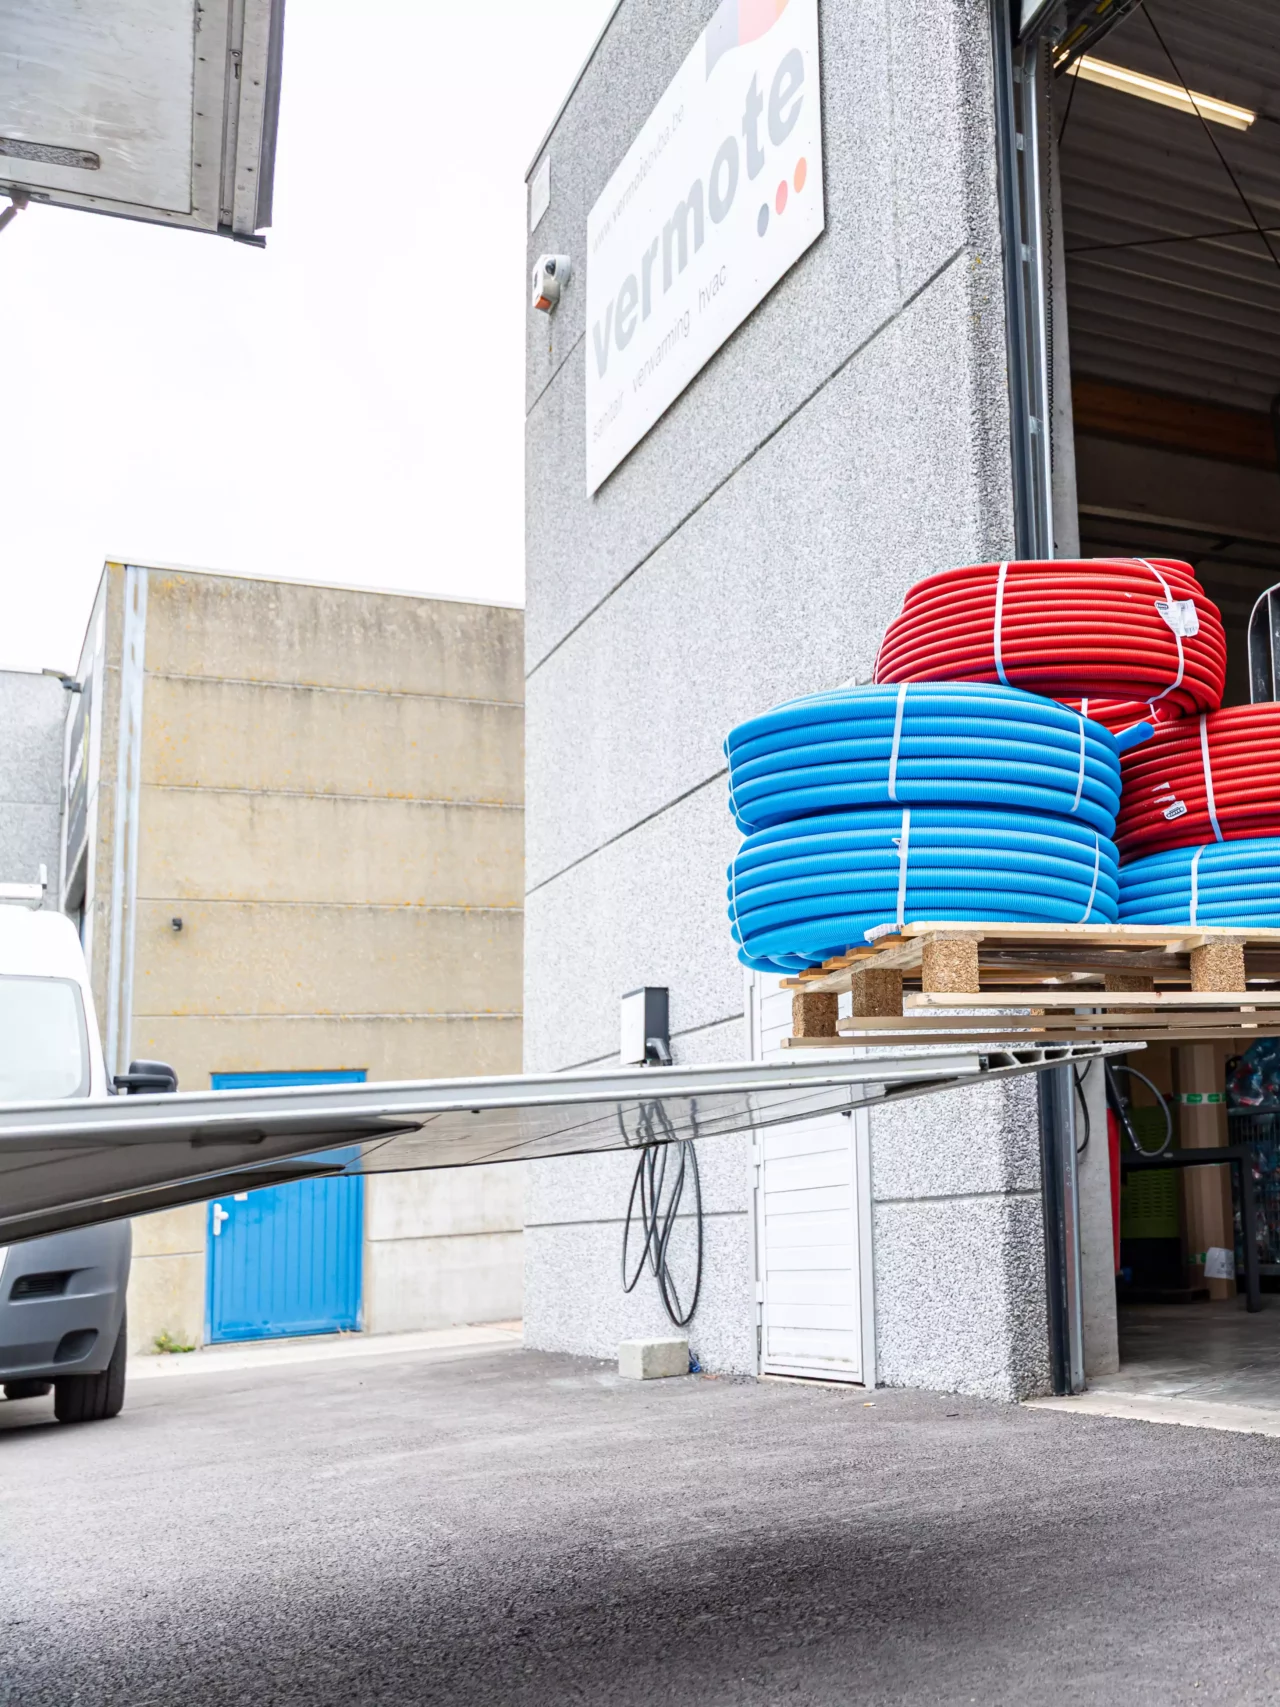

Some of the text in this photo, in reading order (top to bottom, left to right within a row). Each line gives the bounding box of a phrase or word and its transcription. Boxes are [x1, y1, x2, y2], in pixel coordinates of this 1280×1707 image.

[592, 47, 805, 379] vermote
[632, 309, 690, 393] verwarming
[699, 265, 727, 313] hvac
